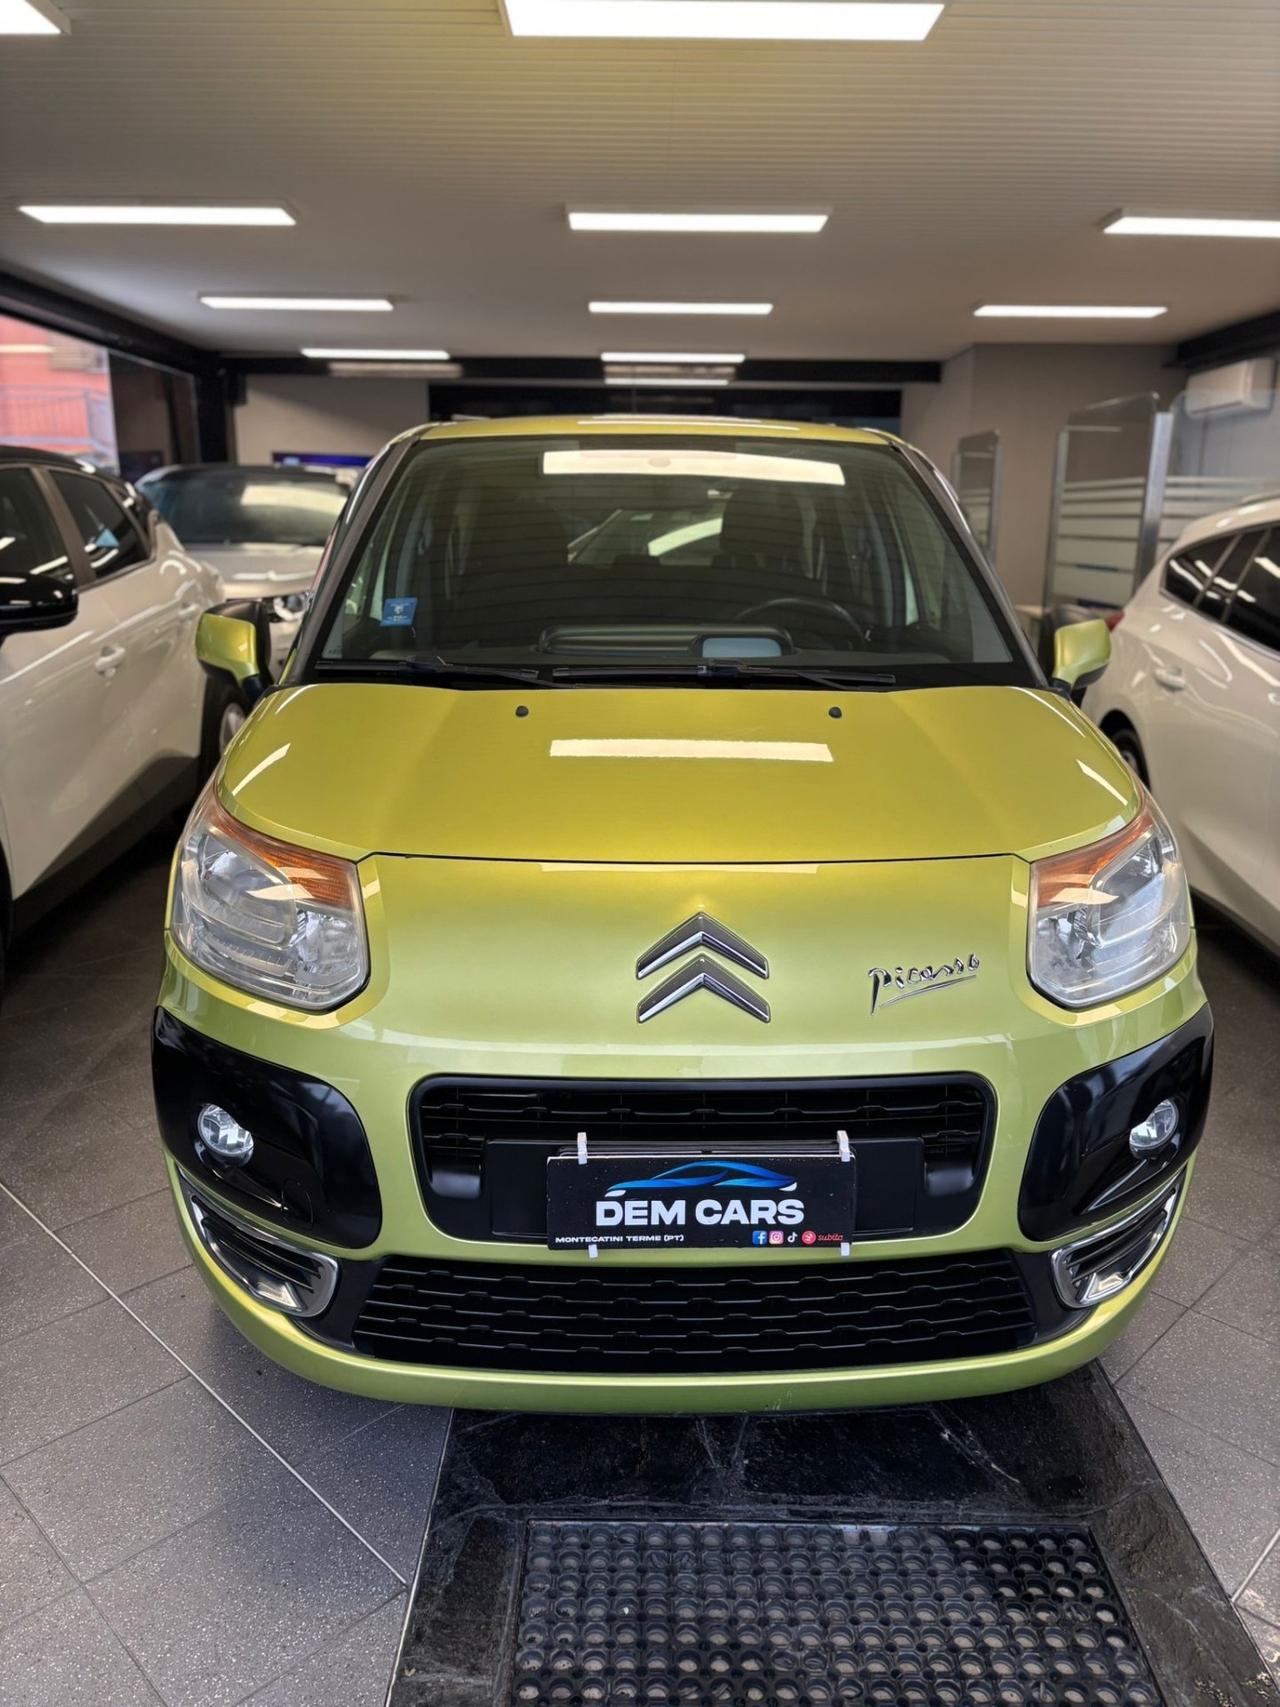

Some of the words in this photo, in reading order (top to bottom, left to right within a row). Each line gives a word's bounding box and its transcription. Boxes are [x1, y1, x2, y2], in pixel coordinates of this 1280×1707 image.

[868, 953, 979, 1016] Picasso
[596, 1200, 686, 1226] DEM
[695, 1199, 805, 1225] CARS
[555, 1235, 623, 1243] MONTECATINI
[664, 1234, 684, 1242] (PT)
[817, 1233, 844, 1241] subito
